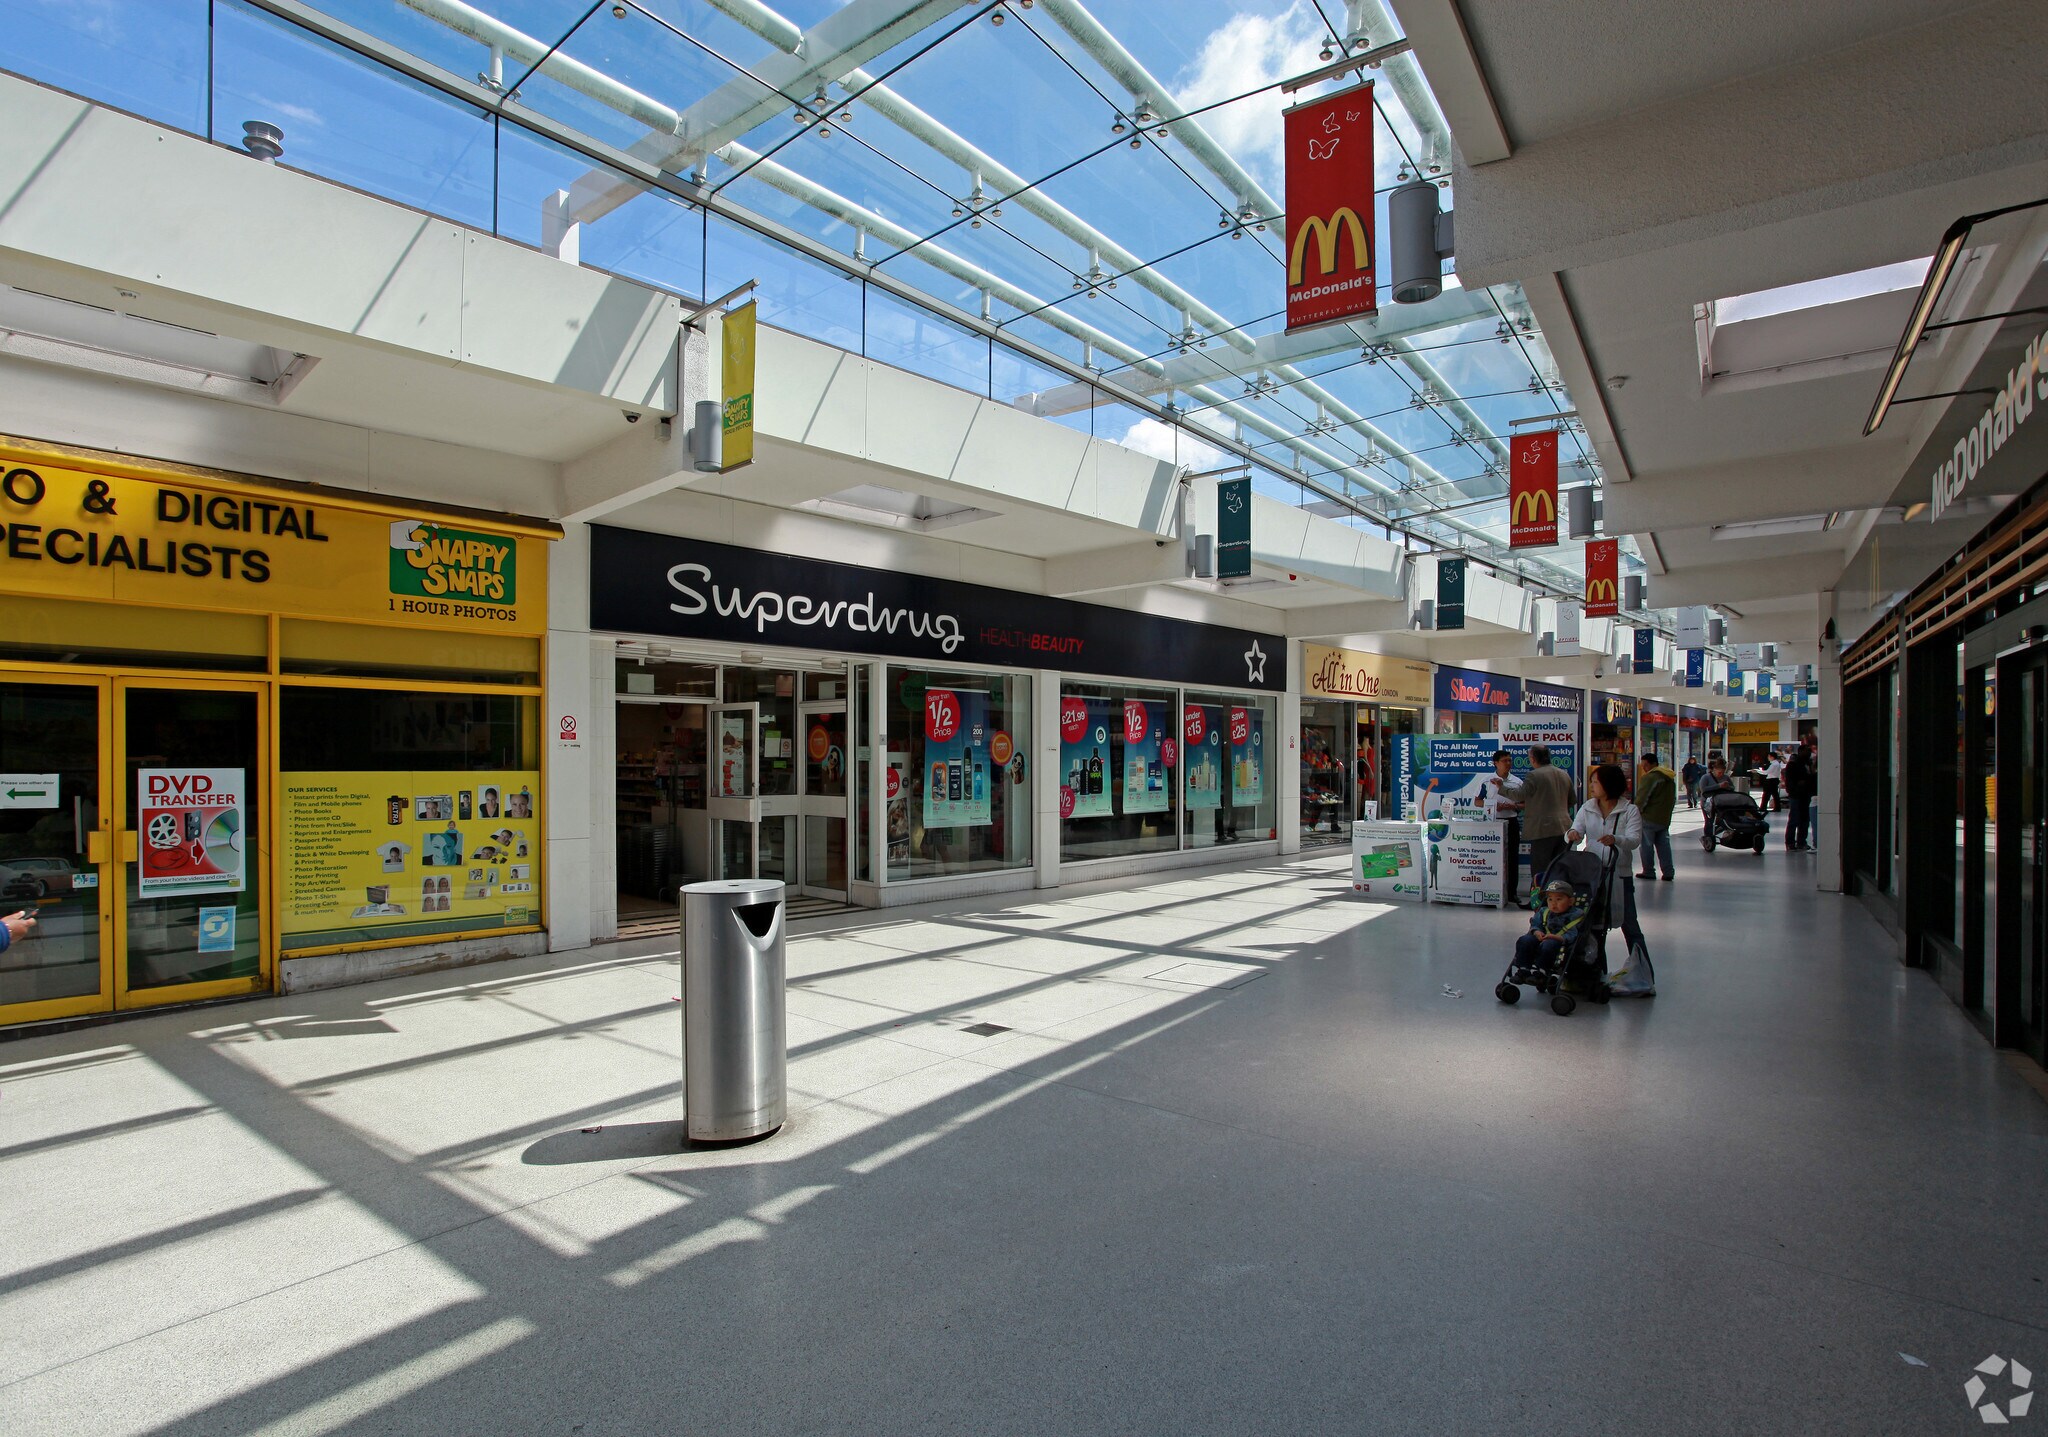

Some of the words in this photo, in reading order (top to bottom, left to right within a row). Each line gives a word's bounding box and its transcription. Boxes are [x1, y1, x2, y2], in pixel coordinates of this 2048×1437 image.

[1289, 275, 1372, 304] McDonald's
[1290, 307, 1341, 323] BUTTERFLY
[1346, 300, 1371, 311] WALK
[1930, 330, 2048, 524] McDonald's
[0, 466, 46, 505] O
[82, 480, 118, 515] &
[158, 489, 329, 542] DIGITAL
[1511, 524, 1557, 534] McDonald's
[406, 528, 510, 573] SNAPPY
[1218, 540, 1251, 548] Superdrug
[0, 523, 271, 583] ECIALISTS
[421, 564, 505, 600] SNAPS
[388, 599, 396, 611] 1
[402, 600, 450, 616] HOUR
[453, 604, 517, 622] PHOTOS
[667, 563, 965, 653] Superdrug
[1312, 660, 1340, 693] All
[1340, 668, 1352, 692] in
[1356, 668, 1381, 694] One
[1381, 688, 1399, 697] LONDON
[1451, 677, 1480, 703] Shoe
[1482, 682, 1509, 705] Zone
[1528, 692, 1547, 707] CANCER
[1547, 695, 1570, 710] RESEARCH
[929, 700, 953, 727] 1/2
[1061, 710, 1086, 725] £21.99
[1126, 709, 1142, 732] 1/2
[1185, 711, 1201, 721] under
[1231, 711, 1244, 721] save
[933, 728, 952, 737] Price
[1187, 720, 1202, 737] £15
[1232, 724, 1246, 739] £25
[1508, 721, 1568, 732] Lycamobile
[1129, 731, 1142, 740] Price
[1503, 733, 1540, 742] VALUE
[1542, 733, 1574, 742] PACK
[1165, 744, 1174, 758] 1/2
[1434, 751, 1476, 759] Lycamobile
[1549, 748, 1572, 757] eekly
[148, 775, 213, 794] DVD
[148, 794, 236, 806] TRANSFER
[1452, 833, 1501, 842] Lycamobile
